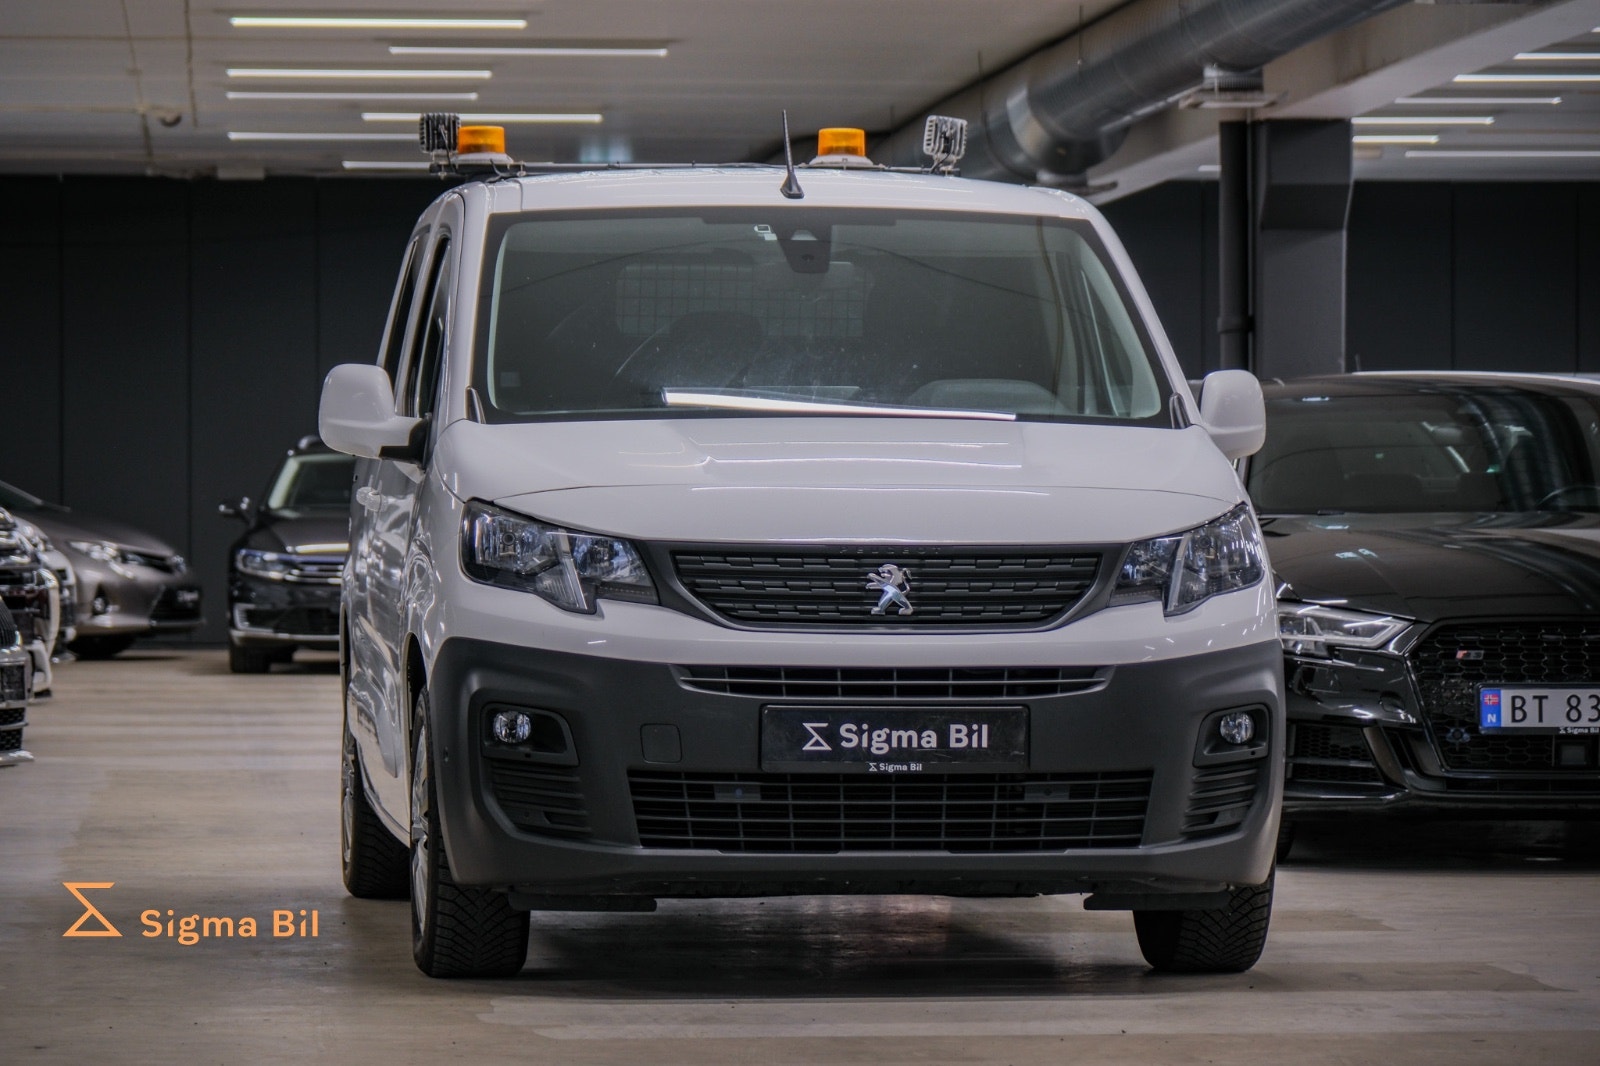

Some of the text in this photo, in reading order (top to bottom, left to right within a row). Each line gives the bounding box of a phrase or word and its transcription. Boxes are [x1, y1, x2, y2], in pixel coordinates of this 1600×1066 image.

[1511, 694, 1600, 723] BT 83
[1487, 713, 1497, 723] N
[1566, 727, 1589, 735] Sigma
[839, 723, 988, 755] Sigma Bil
[879, 763, 923, 773] Sigma Bil
